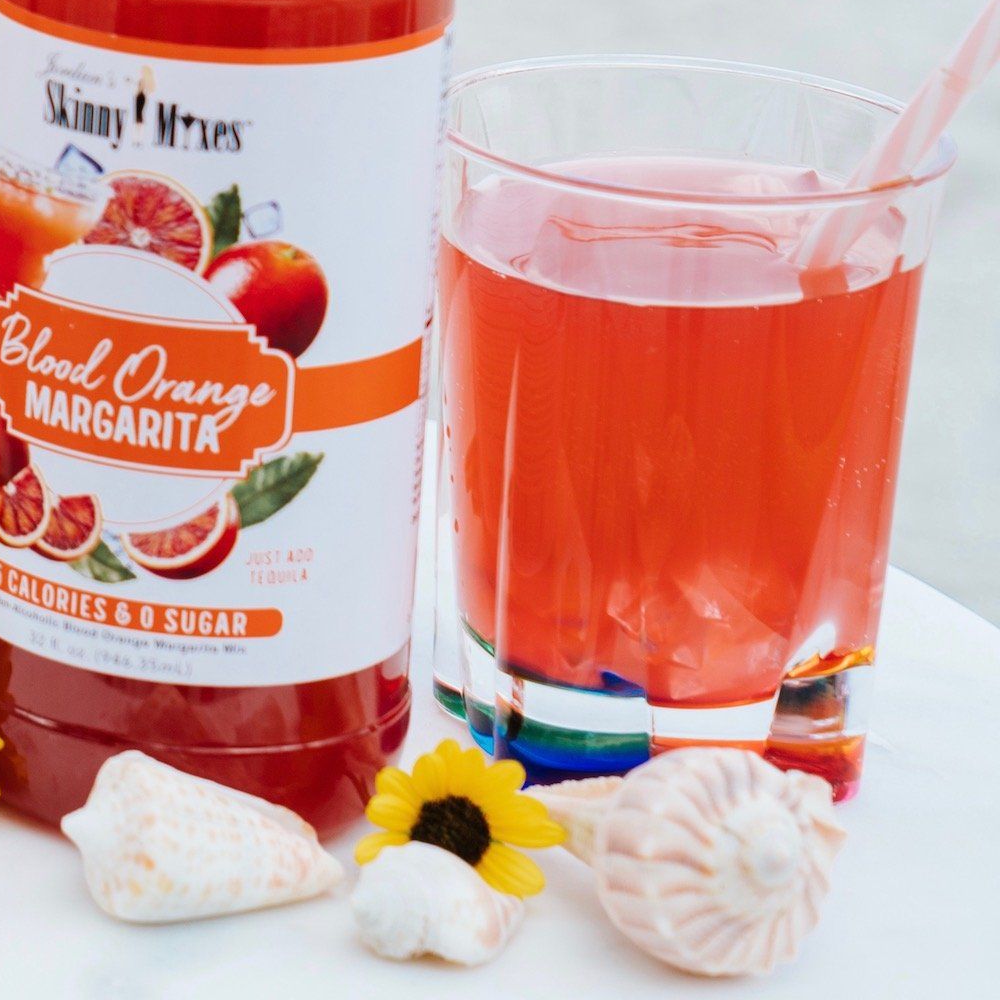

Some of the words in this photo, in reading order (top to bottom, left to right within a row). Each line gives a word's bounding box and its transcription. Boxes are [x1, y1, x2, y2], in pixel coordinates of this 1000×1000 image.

[45, 79, 126, 149] Skinny
[157, 102, 243, 151] Mixes
[0, 312, 113, 390] Blood
[113, 344, 277, 433] Orange
[24, 380, 220, 453] MARGARITA
[246, 550, 281, 566] JUST
[287, 546, 314, 562] ADD
[250, 567, 308, 585] TEQUILA
[7, 568, 108, 622] CALORIES
[115, 600, 132, 626] &
[140, 604, 155, 629] 0
[164, 607, 248, 636] SUGAR
